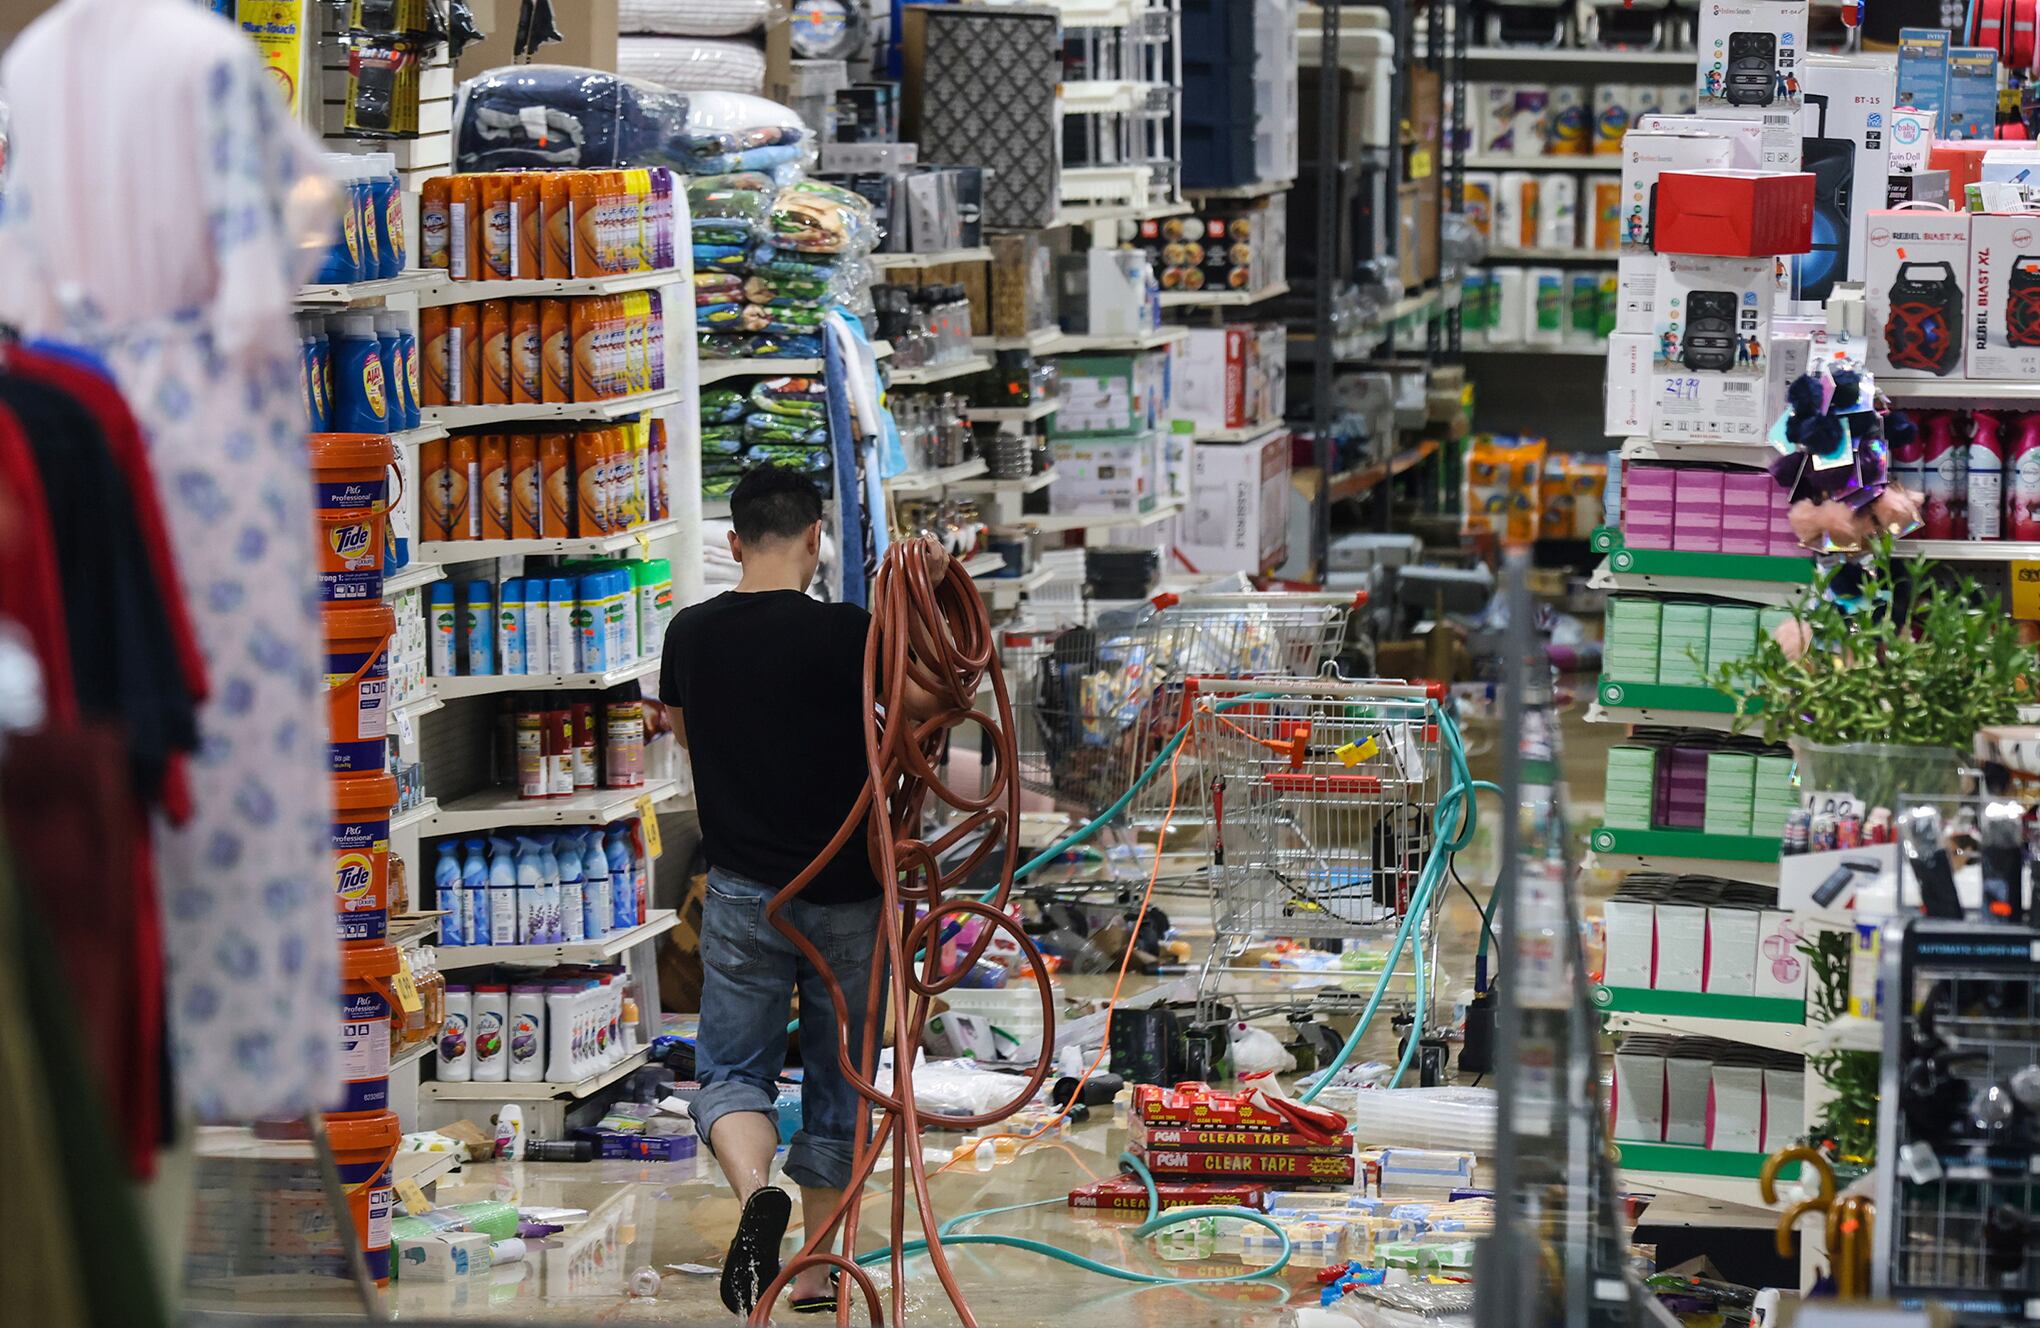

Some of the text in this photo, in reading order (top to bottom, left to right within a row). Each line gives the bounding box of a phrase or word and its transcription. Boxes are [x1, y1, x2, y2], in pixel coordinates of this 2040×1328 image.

[1906, 152, 1921, 160] Doll
[1892, 232, 1921, 240] REBEL
[1976, 247, 1990, 350] REBEL BLAST XL
[331, 493, 372, 502] Professional
[336, 525, 369, 553] Tide
[345, 826, 362, 836] P&G
[332, 833, 373, 843] Professional
[336, 866, 369, 894] Tide
[356, 997, 371, 1006] P&G
[343, 1004, 381, 1014] Professional
[1154, 1131, 1290, 1145] PGM CLEAR TAPE
[1156, 1153, 1189, 1167] PGM
[1205, 1155, 1252, 1172] CLEAR
[1259, 1156, 1295, 1172] TAPE
[1073, 1197, 1097, 1207] PGM
[1113, 1197, 1149, 1207] CLEA
